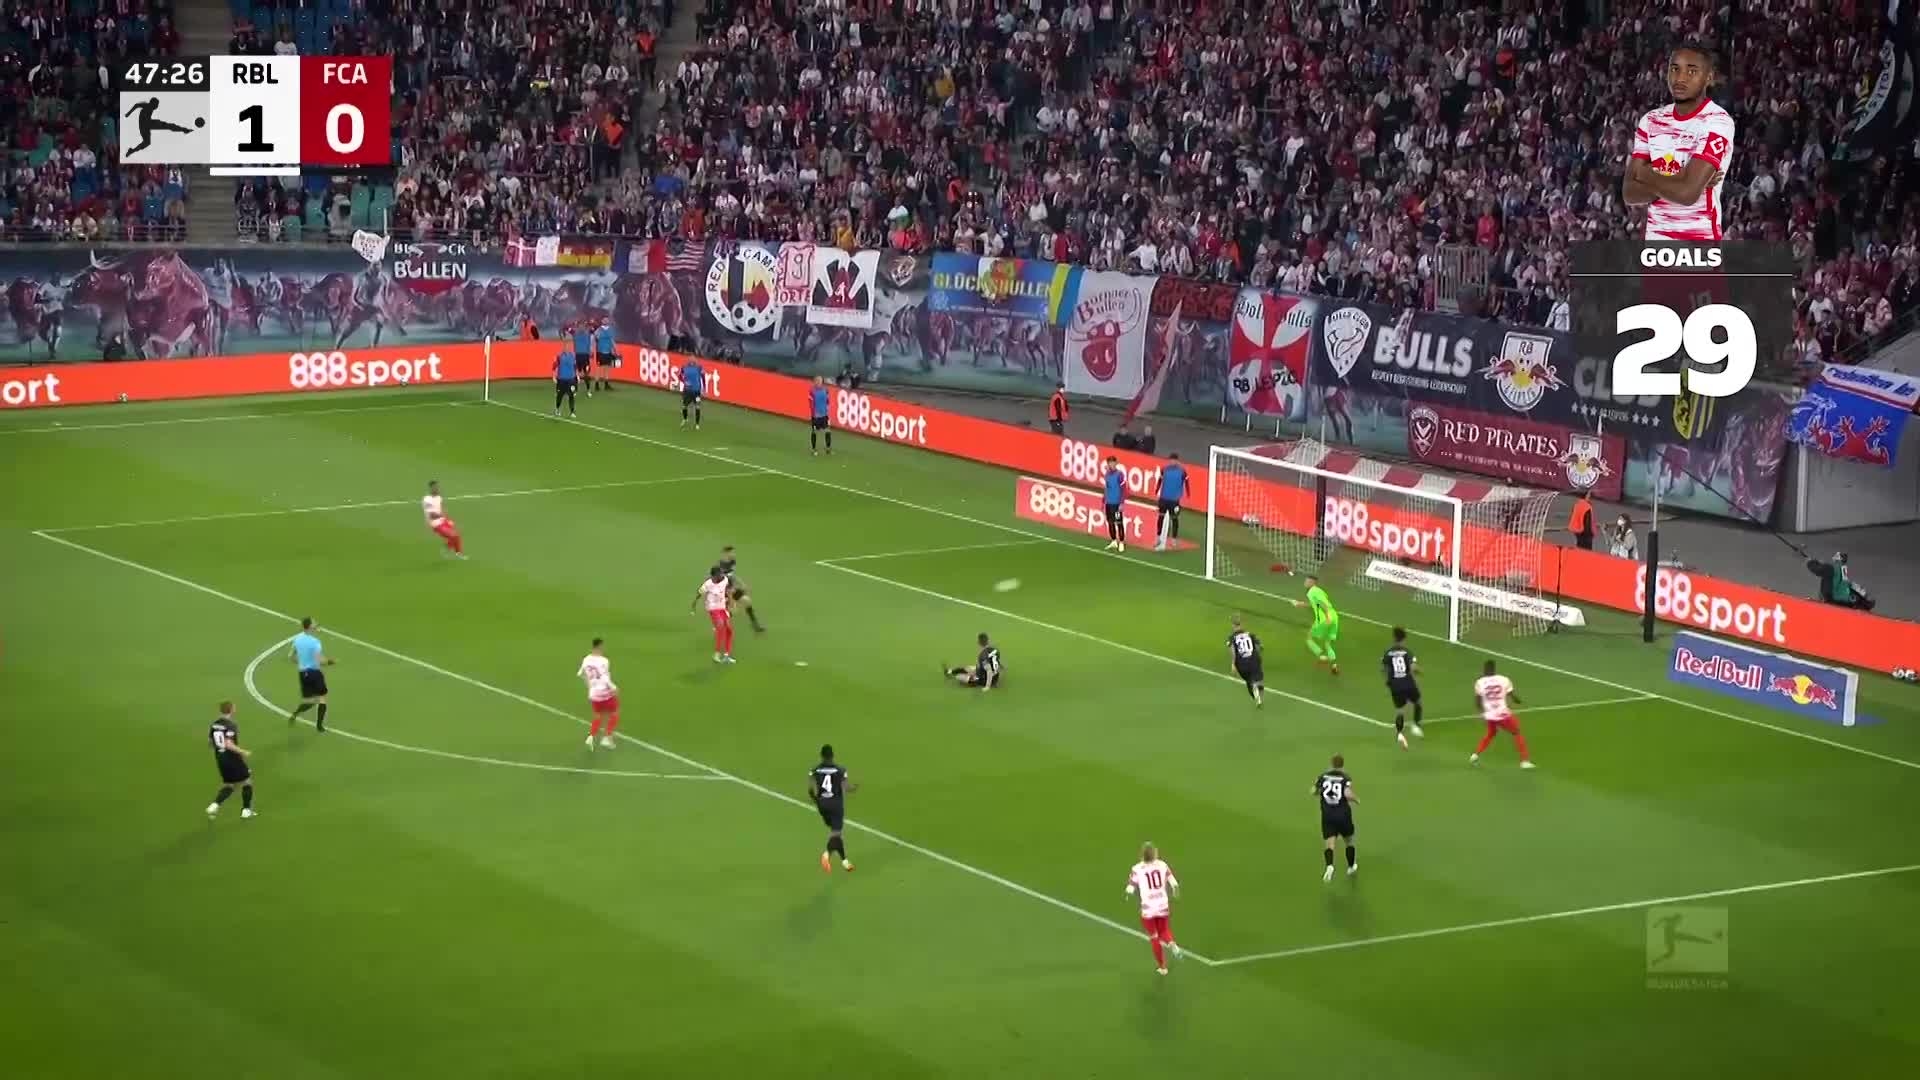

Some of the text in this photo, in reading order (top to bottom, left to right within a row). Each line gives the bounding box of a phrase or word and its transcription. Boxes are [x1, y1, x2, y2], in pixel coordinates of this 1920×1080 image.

[289, 351, 442, 387] 888sport
[1373, 325, 1474, 378] BULLS
[836, 389, 927, 444] 888sport
[1442, 419, 1559, 458] RED PIRATES
[1324, 497, 1445, 561] 888sport
[1675, 647, 1763, 692] Red Bull
[821, 774, 832, 793] 4
[1322, 780, 1342, 801] 29
[1144, 869, 1162, 890] 10
